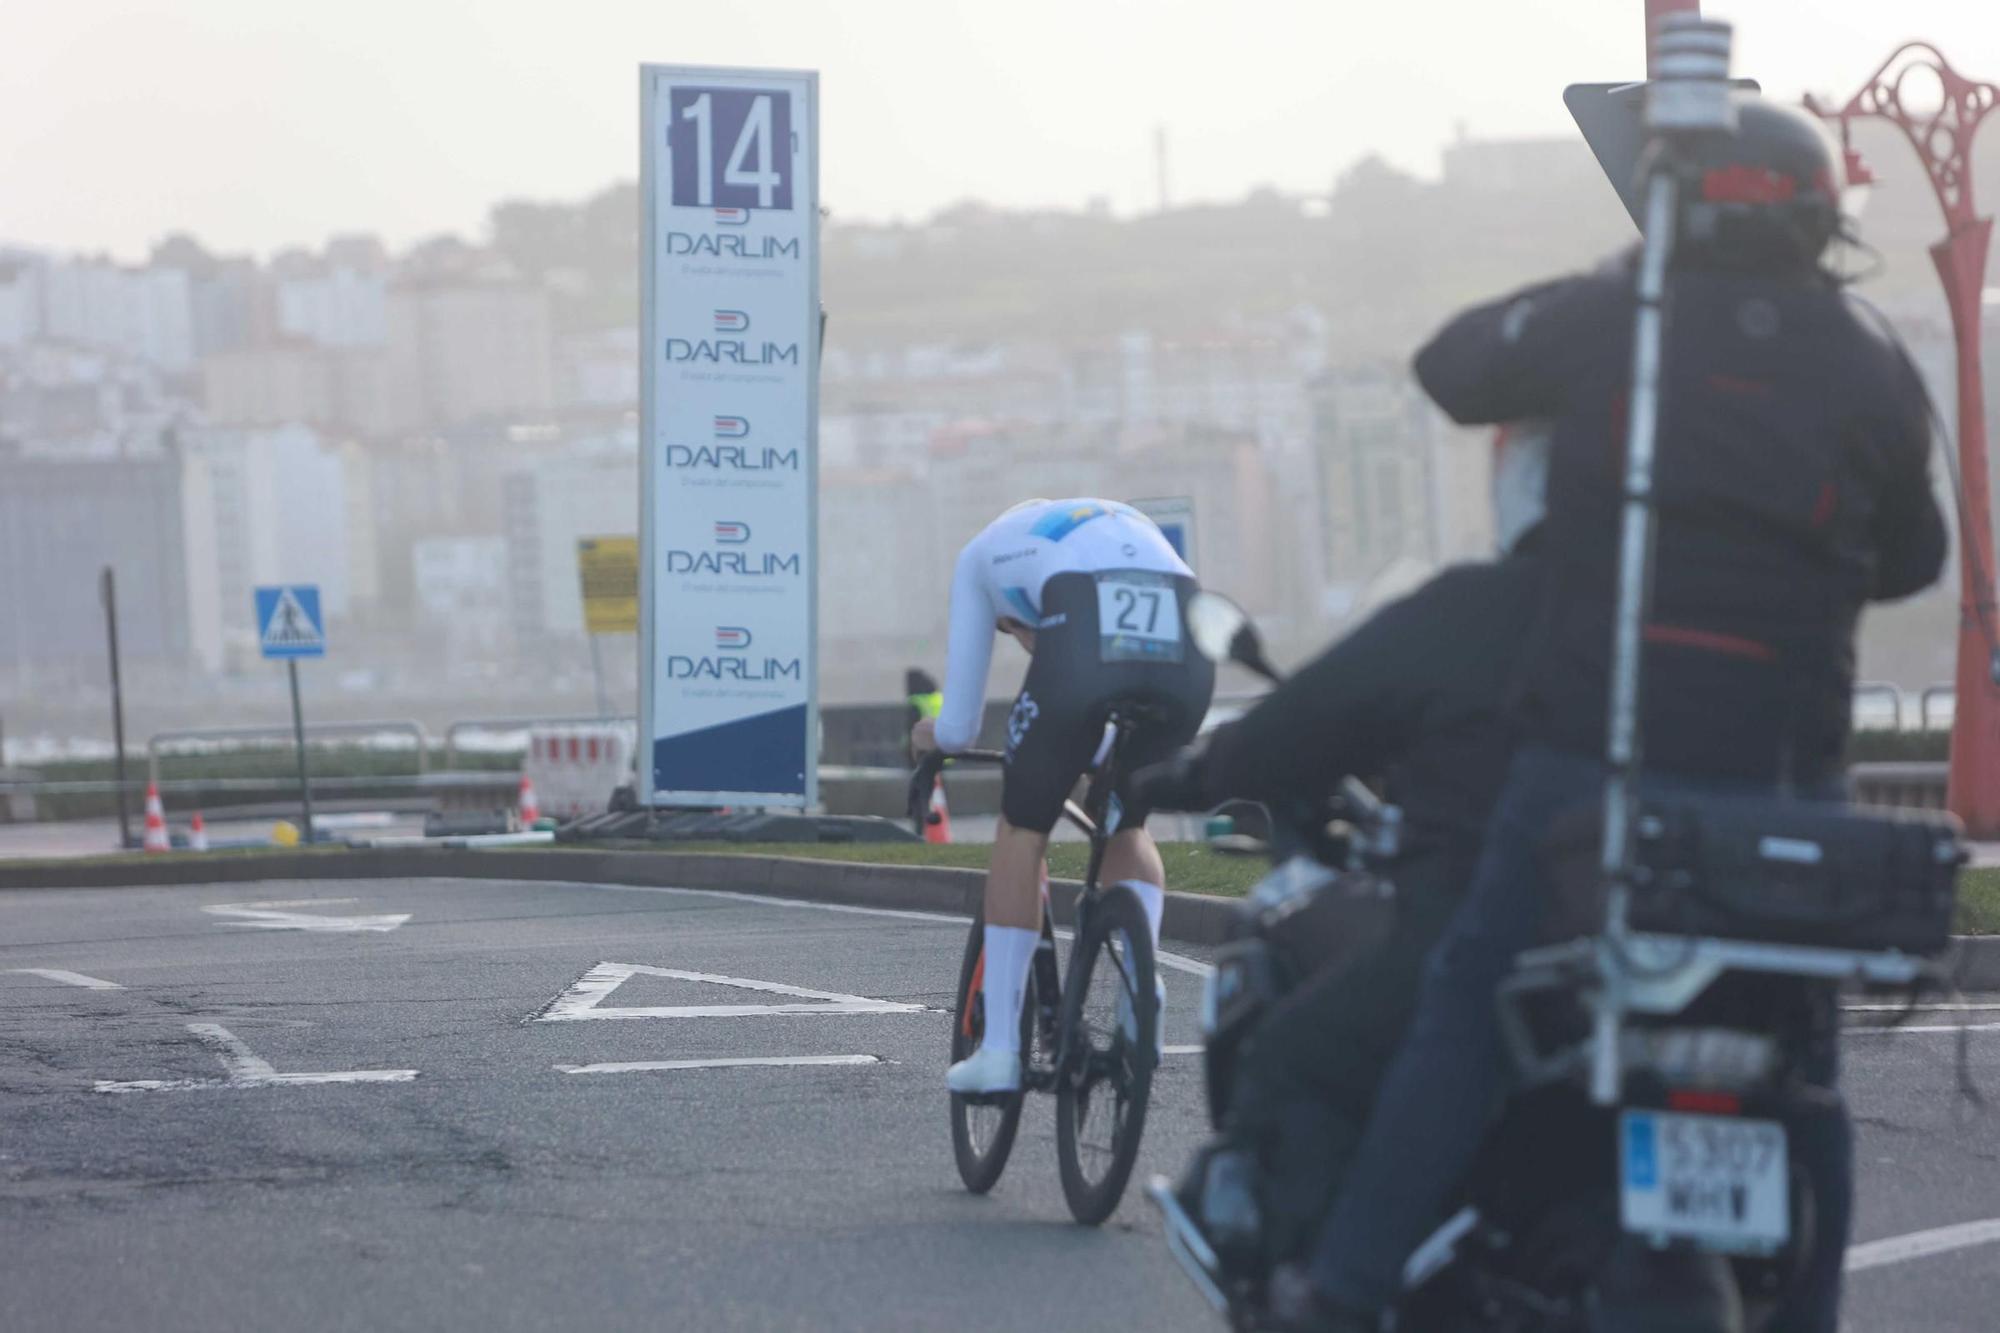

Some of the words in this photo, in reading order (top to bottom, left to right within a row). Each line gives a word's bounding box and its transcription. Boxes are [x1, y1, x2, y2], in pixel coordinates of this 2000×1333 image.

[682, 93, 781, 207] 14
[666, 231, 799, 259] DARLIM
[665, 338, 798, 365] DARLIM
[666, 444, 798, 470] DARLIM
[667, 550, 800, 575] DARLIM
[1115, 587, 1160, 633] 27
[668, 655, 801, 680] DARLIM
